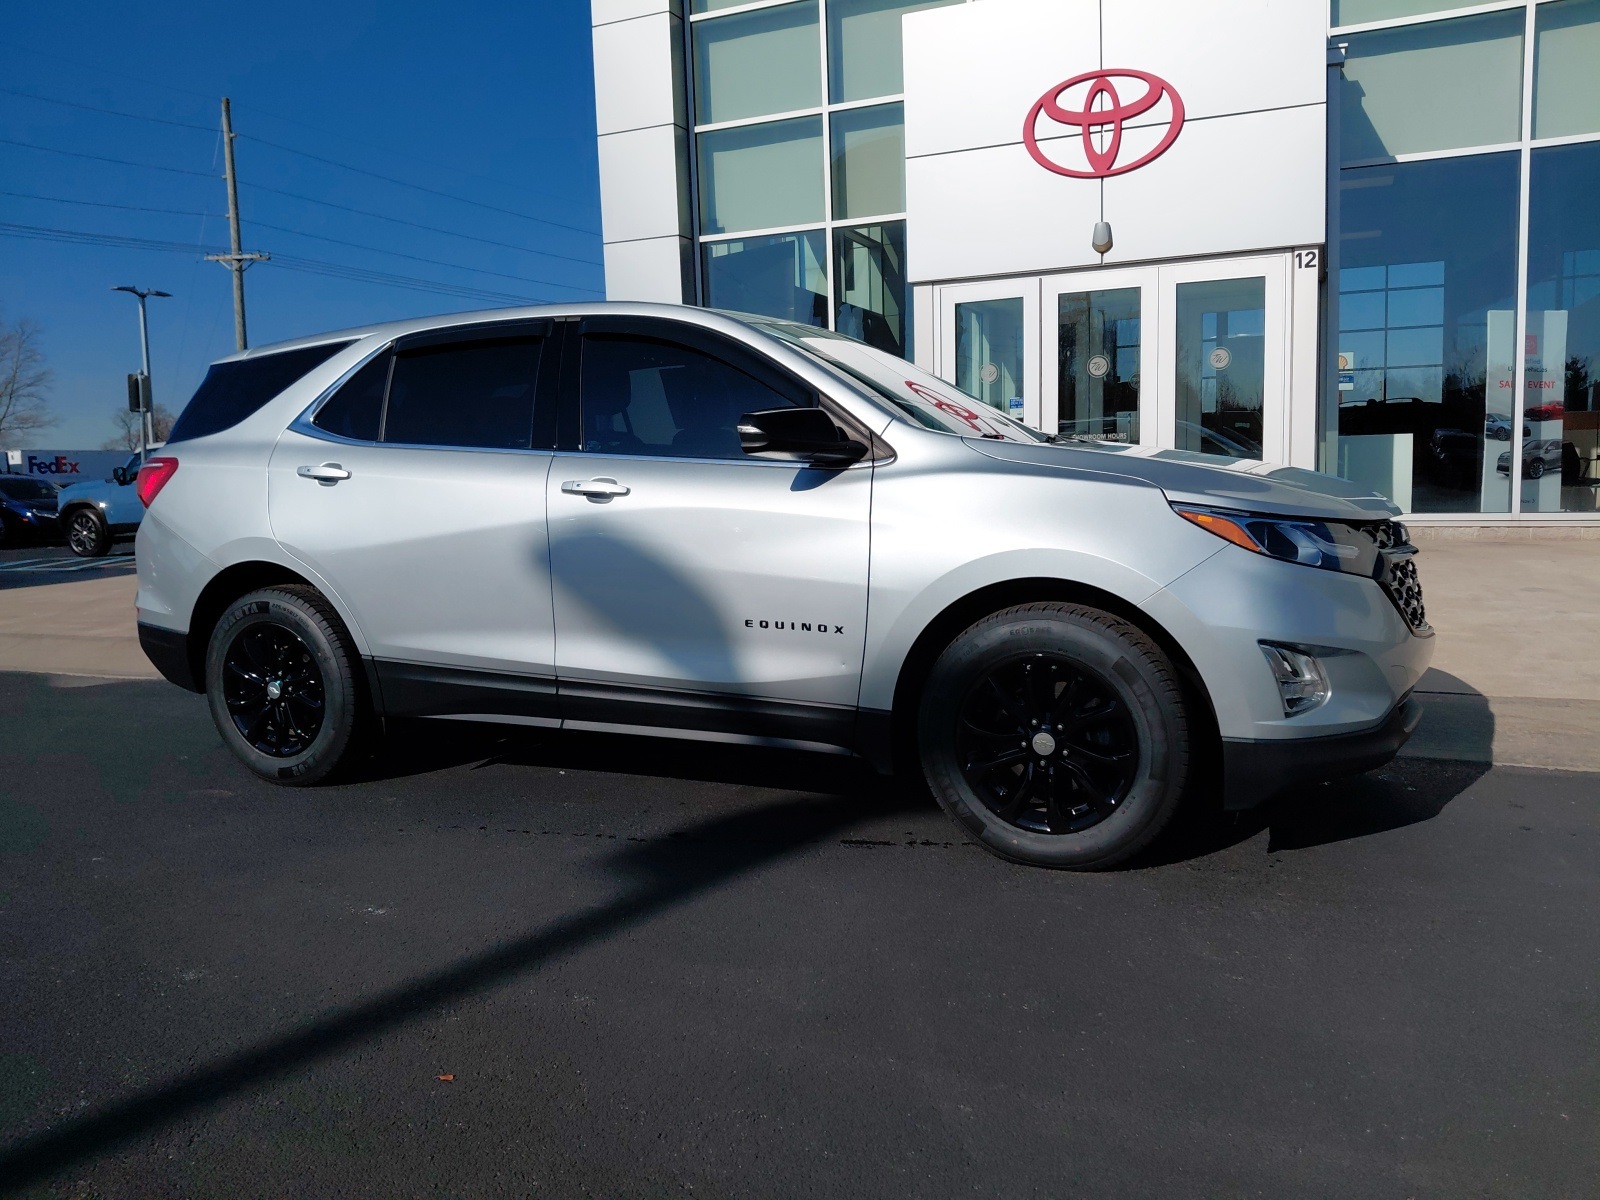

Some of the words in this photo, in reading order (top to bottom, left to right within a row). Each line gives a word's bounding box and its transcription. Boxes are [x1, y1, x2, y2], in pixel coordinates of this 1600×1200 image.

[1295, 250, 1318, 269] 12
[1527, 380, 1556, 389] EVENT
[1107, 432, 1127, 440] HOURS
[27, 455, 81, 474] FedEx
[744, 619, 844, 635] EQUINOX
